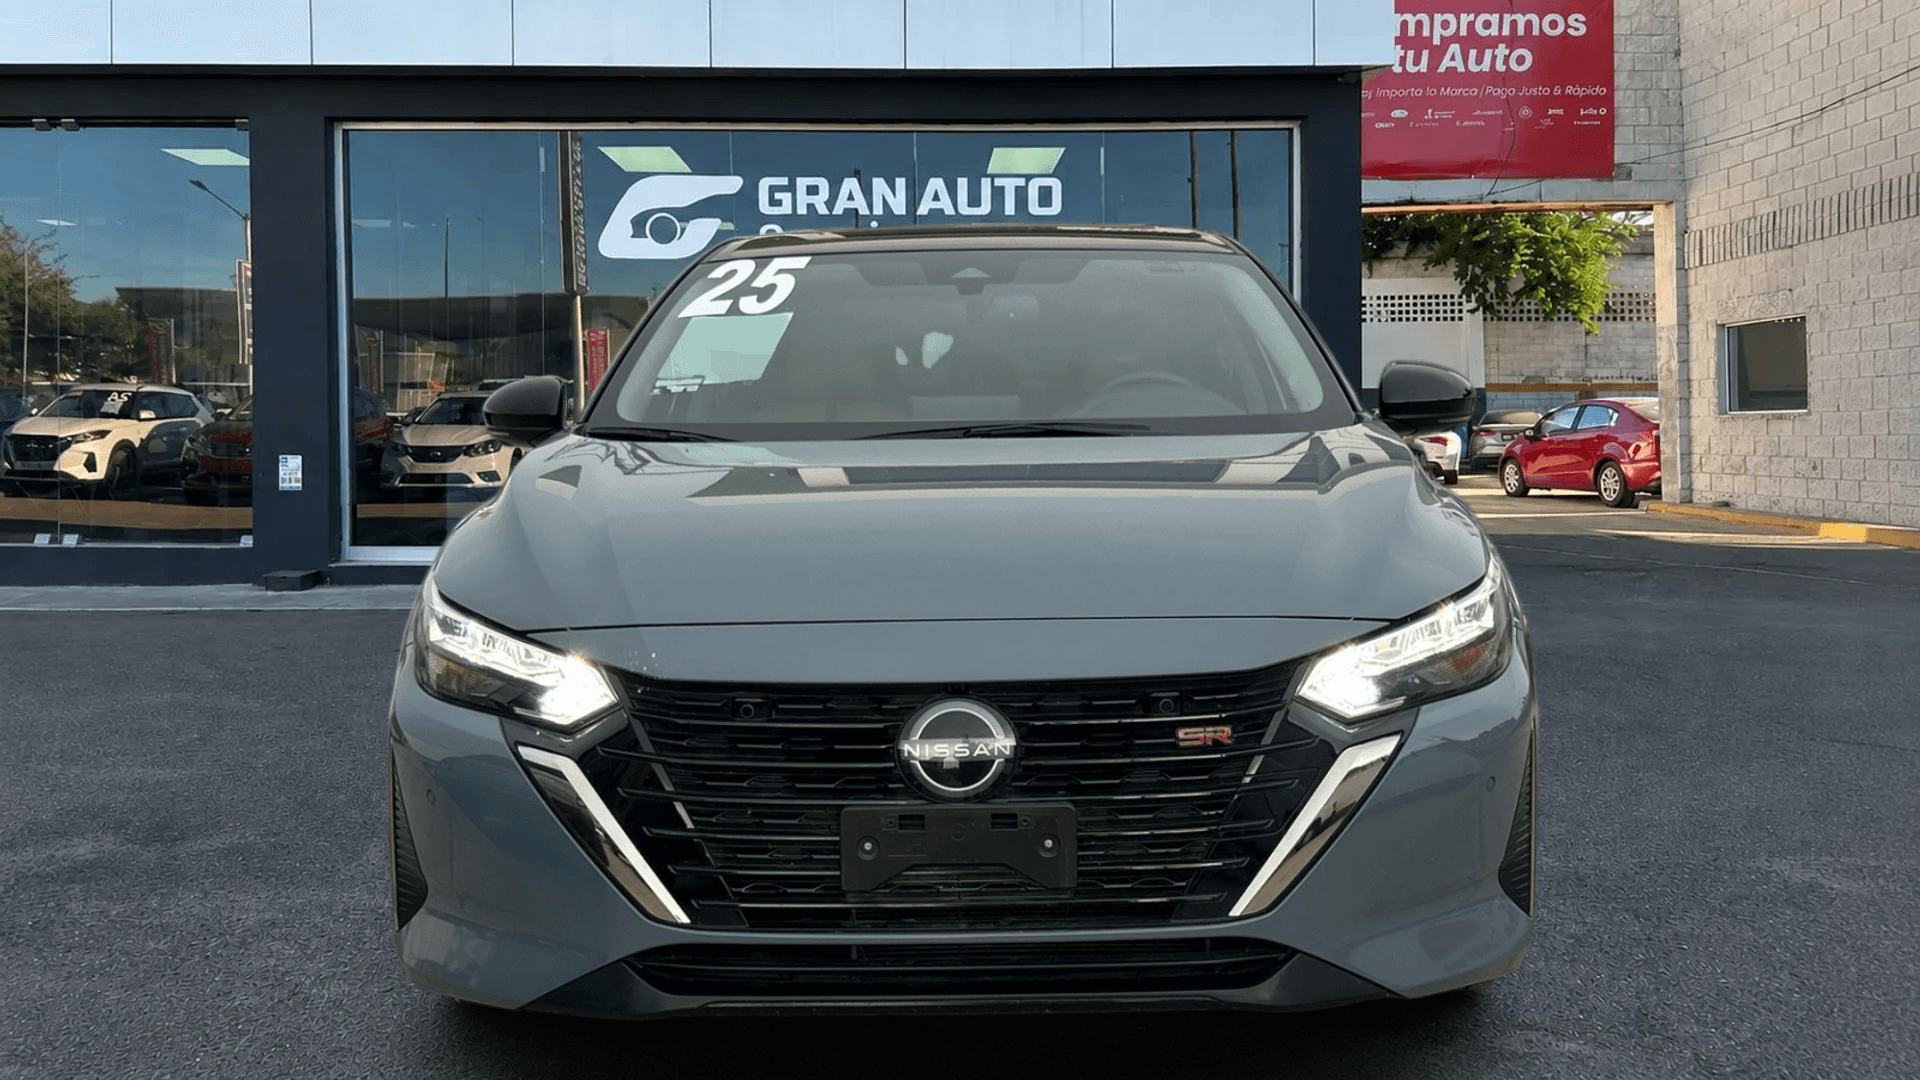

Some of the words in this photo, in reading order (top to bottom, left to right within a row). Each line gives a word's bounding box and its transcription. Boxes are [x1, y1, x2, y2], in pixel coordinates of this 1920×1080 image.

[1392, 44, 1429, 73] tu
[1436, 43, 1533, 73] Auto
[1519, 86, 1551, 96] Justo
[1553, 86, 1562, 96] &
[1565, 84, 1607, 98] Rápido
[758, 177, 907, 216] GRAN
[916, 177, 1063, 216] AUTO
[677, 256, 813, 318] 25
[1178, 726, 1233, 747] SR
[903, 743, 1011, 757] NISSAN
